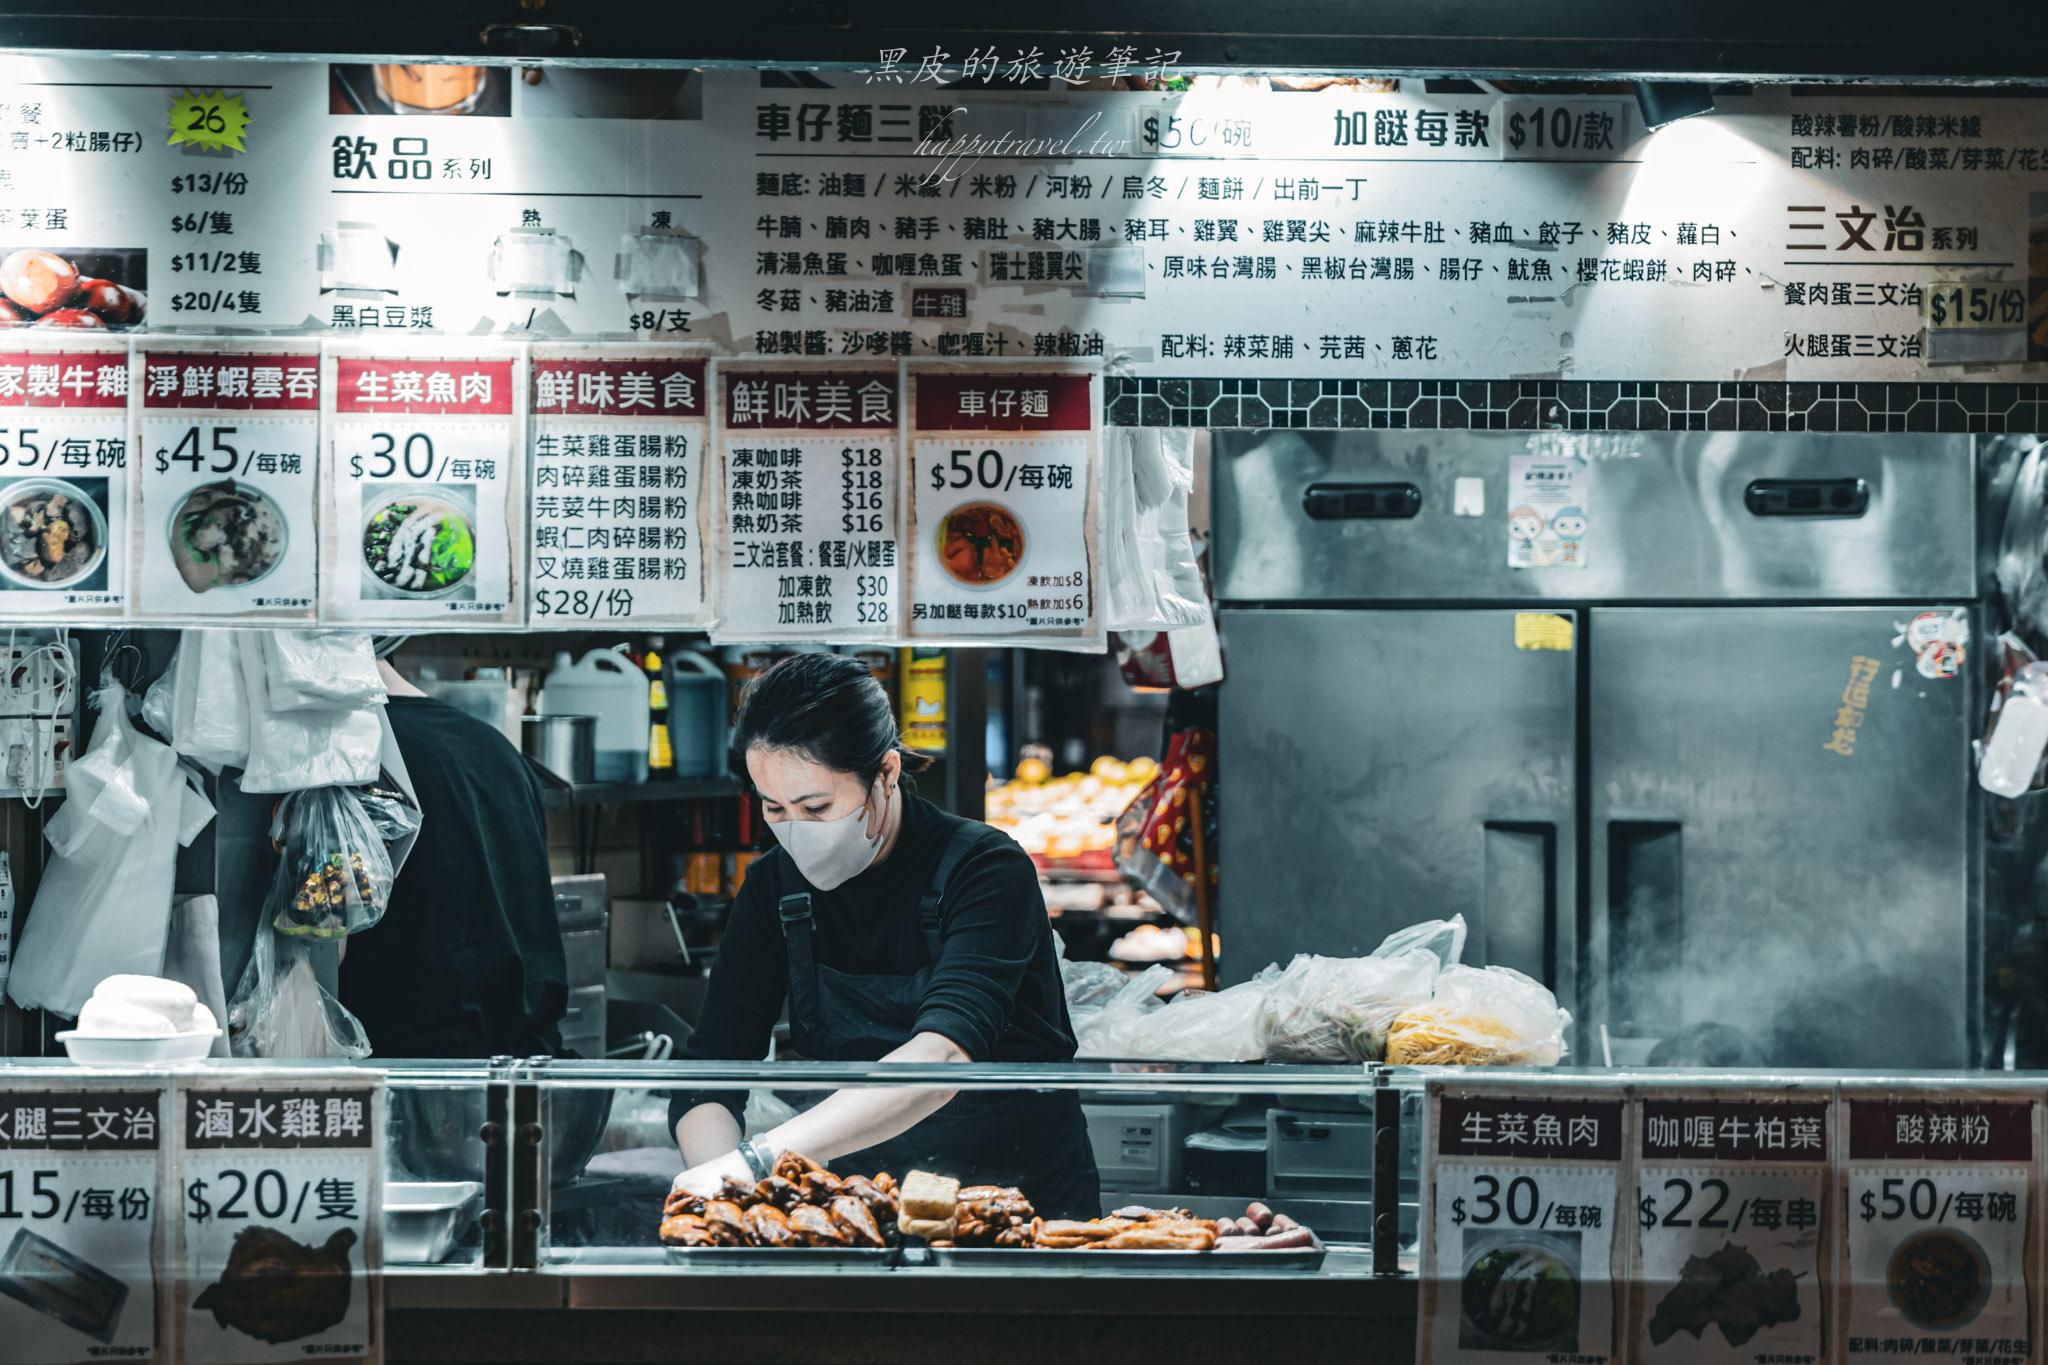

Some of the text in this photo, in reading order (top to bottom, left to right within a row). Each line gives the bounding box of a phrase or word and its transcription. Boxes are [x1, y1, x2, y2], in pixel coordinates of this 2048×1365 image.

[188, 105, 226, 133] 26
[756, 103, 954, 143] 車仔麵三餸
[1333, 109, 1490, 147] 加餸每款
[1508, 106, 1614, 151] $10/款
[1791, 114, 1981, 139] 酸辣薯粉/酸辣米線
[332, 136, 491, 180] 飲品系列
[1791, 146, 1841, 170] 配料:
[172, 172, 249, 196] $13/份
[756, 172, 810, 199] 麵底:
[818, 172, 866, 199] 油麵
[970, 174, 1017, 199] 米粉
[1046, 174, 1093, 199] 河粉
[1122, 176, 1168, 199] 烏冬
[1198, 176, 1244, 201] 麵餅
[1274, 176, 1368, 201] 出前一丁
[172, 211, 234, 235] $6/隻
[522, 209, 541, 228] 熱
[652, 210, 672, 229] 凍
[1786, 205, 1978, 251] 三文治系列
[172, 251, 262, 275] $11/2隻
[990, 251, 1083, 281] 瑞士雞翼尖
[172, 290, 262, 314] $20/4隻
[757, 288, 962, 316] 冬菇、豬油渣 牛雜
[1784, 282, 1922, 306] 餐肉蛋三文治
[1931, 287, 2026, 325] $15/份
[331, 305, 433, 329] 黑白豆漿
[630, 310, 692, 333] $8/支
[756, 330, 833, 356] 秘製醬:
[1161, 334, 1214, 358] 配料:
[1784, 334, 1921, 358] 火腿蛋三文治
[0, 365, 128, 397] 家製牛雜
[148, 366, 318, 399] 淨鮮蝦雲吞
[356, 371, 492, 404] 生菜魚肉
[535, 371, 696, 409] 鮮味美食
[732, 380, 893, 424] 鮮味美食
[958, 389, 1049, 418] 車仔麵
[156, 427, 301, 475] $45/每碗
[350, 433, 496, 481] $30/每碗
[536, 435, 688, 458] 生菜雞蛋腸粉
[732, 448, 882, 468] 凍咖啡 $18
[536, 465, 688, 489] 肉碎雞蛋腸粉
[732, 470, 882, 490] 凍奶茶 $18
[931, 449, 1073, 491] $50/每碗
[536, 496, 688, 520] 芫荽牛肉腸粉
[732, 491, 882, 511] 熱咖啡 $16
[732, 513, 882, 533] 熱奶茶 $16
[536, 526, 688, 550] 蝦仁肉碎腸粉
[536, 557, 688, 580] 叉燒雞蛋腸粉
[1027, 571, 1083, 587] 凍飲加$8
[778, 574, 888, 598] 加凍飲 $30
[536, 589, 633, 618] $28/份
[778, 601, 888, 624] 加熱飲 $28
[912, 603, 1027, 620] 另加餸每款$10
[1027, 594, 1083, 610] 熱飲加$6
[196, 1098, 364, 1140] 滷水雞髀
[1460, 1111, 1599, 1147] 生菜魚肉
[1648, 1115, 1822, 1148] 咖喱牛柏葉
[1896, 1114, 1990, 1145] 酸辣粉
[188, 1169, 359, 1224] $20/隻
[1451, 1174, 1602, 1228] $30/每碗
[1639, 1178, 1817, 1233] $22/每串
[1860, 1178, 2017, 1223] $50/每碗
